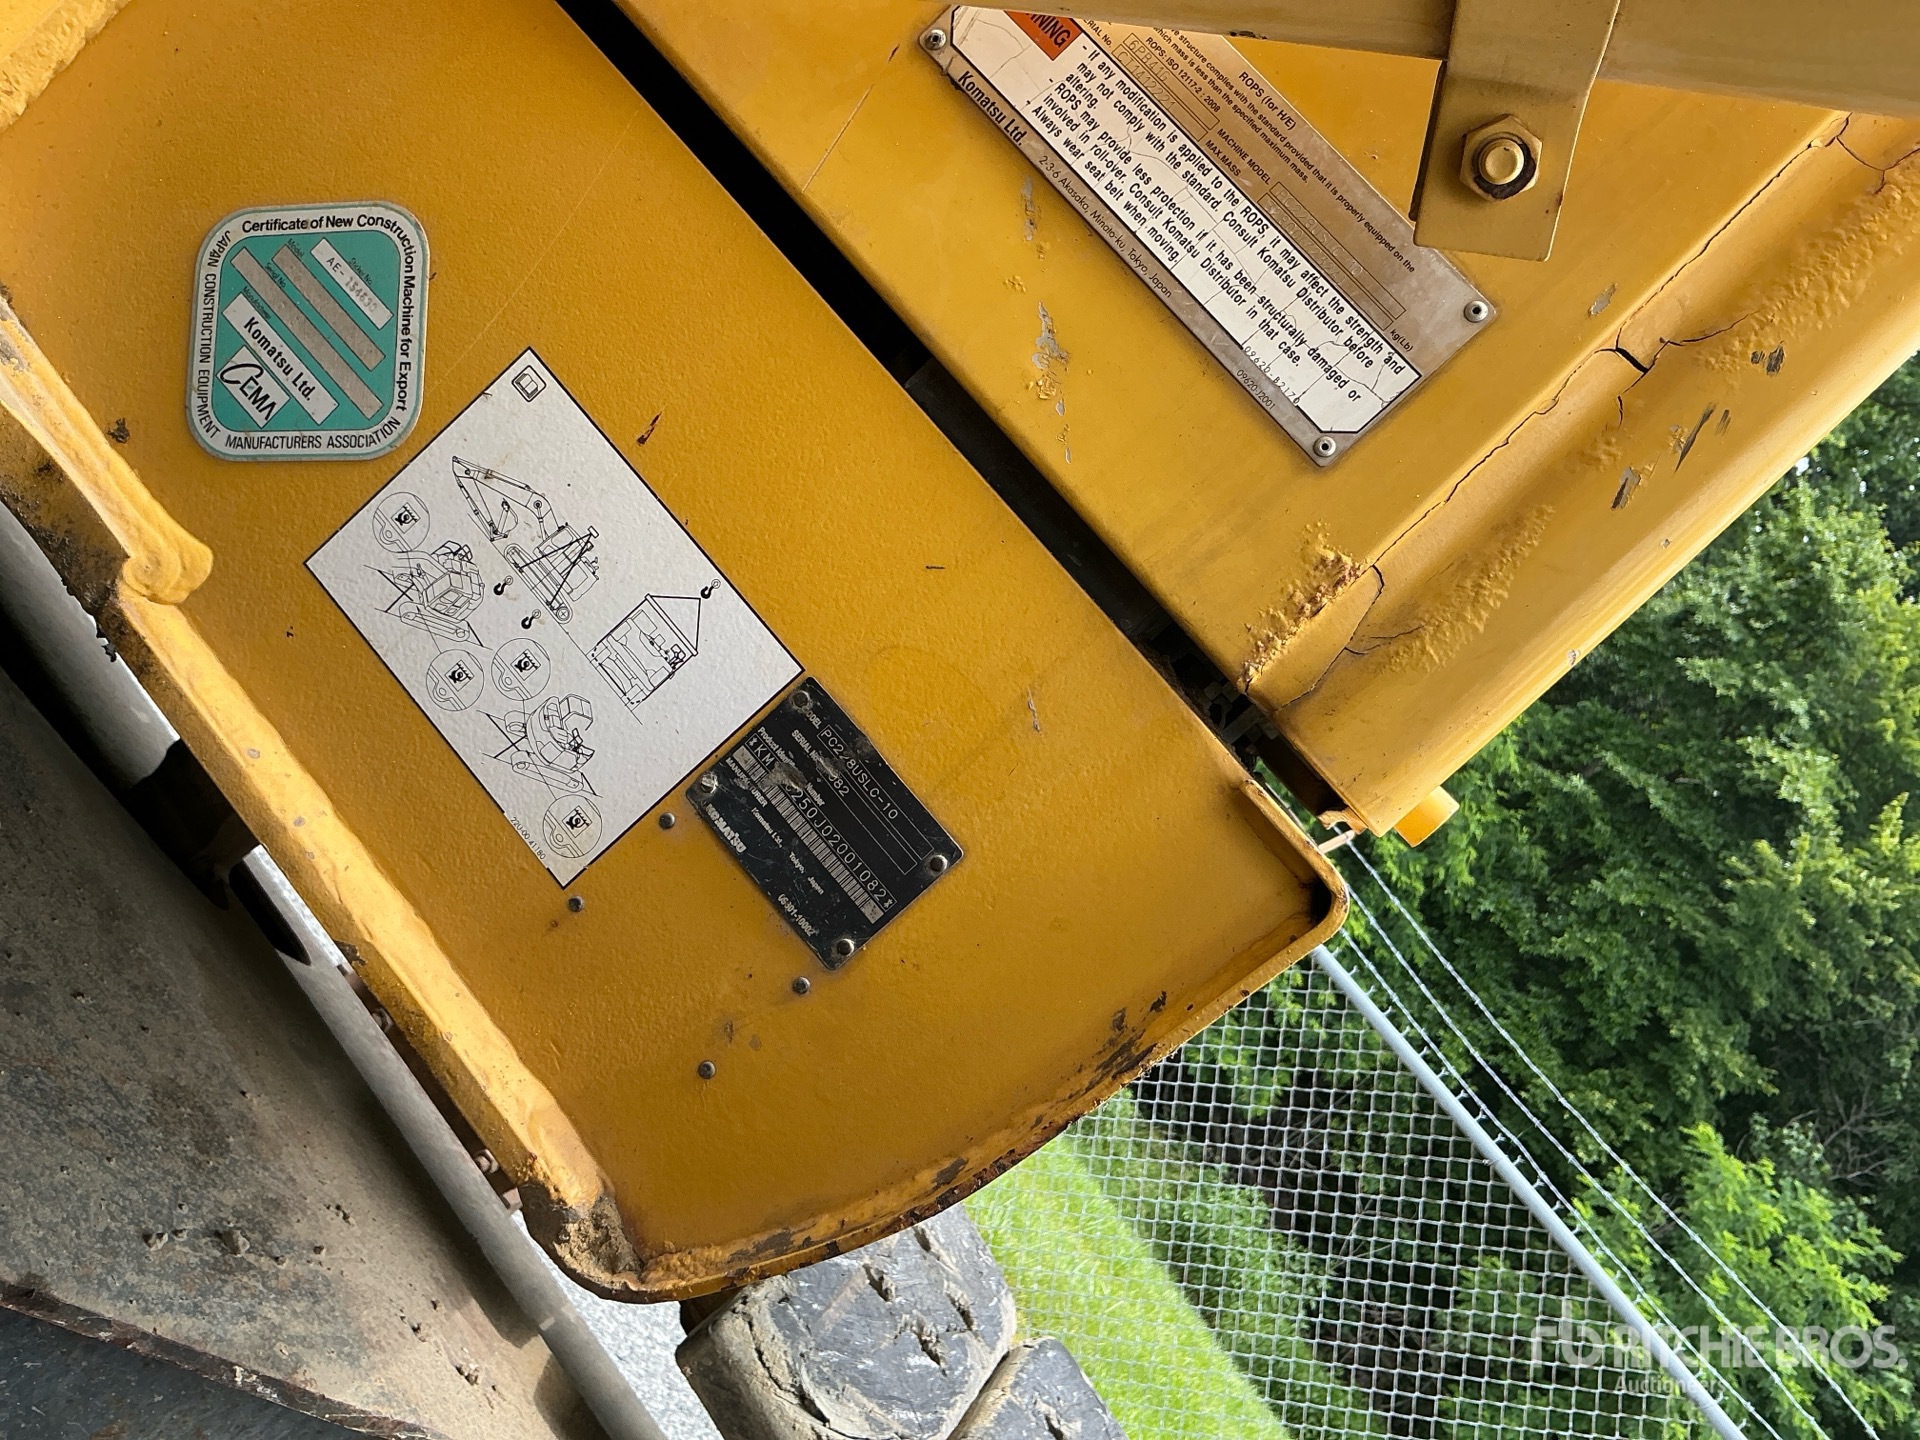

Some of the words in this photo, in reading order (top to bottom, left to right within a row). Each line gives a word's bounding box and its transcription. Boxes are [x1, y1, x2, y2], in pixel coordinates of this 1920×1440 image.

[1101, 34, 1114, 48] No.
[1062, 72, 1101, 111] altering.
[1145, 36, 1168, 59] ROPS:
[1164, 56, 1180, 71] ISO
[1176, 68, 1202, 94] 12117-2
[1203, 95, 1221, 113] 2008
[1170, 42, 1189, 61] mass
[1186, 58, 1196, 68] is
[1193, 64, 1209, 81] less
[1206, 77, 1223, 95] than
[1220, 92, 1234, 106] the
[1230, 102, 1262, 135] specified
[1259, 130, 1292, 164] maximum
[1237, 71, 1265, 98] ROPS
[1260, 94, 1279, 113] (for
[1275, 109, 1296, 131] H/E)
[956, 70, 1009, 124] Komatsu
[1002, 118, 1030, 147] Ltd.
[1177, 33, 1208, 64] structure
[1204, 60, 1235, 92] complies
[1232, 88, 1249, 105] with
[1246, 102, 1260, 116] the
[1256, 113, 1286, 143] standard
[1282, 139, 1314, 172] provided
[1311, 167, 1327, 183] that
[1324, 180, 1333, 189] it
[1329, 186, 1339, 196] is
[1335, 192, 1366, 224] properly
[1361, 219, 1395, 254] equipped
[1392, 250, 1404, 263] on
[1402, 259, 1416, 273] the
[1204, 139, 1241, 177] MAX.MASS
[1216, 127, 1249, 161] MACHINE
[1245, 158, 1273, 185] MODEL
[1029, 104, 1065, 140] Always
[1062, 137, 1085, 160] wear
[1083, 159, 1106, 182] seat
[1103, 179, 1125, 201] belt
[1121, 198, 1149, 227] when
[1143, 223, 1184, 265] moving.
[1087, 49, 1100, 62] If
[1094, 60, 1116, 82] any
[1114, 77, 1168, 132] modification
[1166, 129, 1180, 144] is
[1175, 141, 1213, 179] applied
[1210, 175, 1224, 190] to
[1222, 187, 1242, 207] the
[1237, 204, 1272, 239] ROPS,
[1268, 235, 1282, 248] it
[1276, 247, 1301, 272] may
[1299, 267, 1330, 298] affect
[1326, 295, 1347, 316] the
[1342, 313, 1385, 357] strength
[1382, 352, 1405, 376] and
[242, 218, 308, 233] Certificate
[310, 216, 324, 229] of
[325, 215, 353, 229] New
[356, 214, 416, 274] Construction
[1037, 154, 1062, 180] 2-3-6
[1056, 175, 1094, 213] Akasaka,
[1087, 208, 1130, 252] Minato-ku,
[1124, 247, 1153, 277] Tokyo,
[1146, 271, 1175, 299] Japan
[1042, 93, 1081, 132] involved
[1077, 129, 1092, 144] in
[1088, 142, 1131, 184] roll-over.
[1127, 181, 1165, 219] Consult
[1161, 216, 1203, 259] Komatsu
[1198, 256, 1249, 308] Distributor
[1245, 304, 1260, 320] in
[1257, 317, 1280, 341] that
[1276, 339, 1304, 367] case.
[1053, 82, 1082, 111] ROPS
[1077, 110, 1100, 133] may
[1096, 129, 1134, 167] provide
[1131, 162, 1154, 186] less
[1149, 183, 1198, 232] protection
[1195, 228, 1208, 241] if
[1214, 249, 1236, 271] has
[1233, 268, 1259, 295] been
[1253, 292, 1310, 349] structurally
[1303, 344, 1350, 391] damaged
[1346, 388, 1362, 403] or
[1074, 62, 1097, 85] may
[1095, 80, 1115, 100] not
[1110, 97, 1147, 134] comply
[1144, 129, 1167, 153] with
[1164, 150, 1184, 170] the
[1180, 167, 1224, 212] standard.
[1221, 209, 1259, 248] Consult
[1256, 246, 1298, 288] Komatsu
[1295, 286, 1346, 337] Distributor
[1342, 335, 1376, 369] before
[207, 230, 231, 267] JAPAN
[199, 273, 217, 363] CONSTRUCTION
[400, 275, 415, 336] Machine
[243, 317, 293, 376] Komatsu
[292, 372, 316, 401] Ltd.
[400, 338, 412, 358] for
[1388, 327, 1413, 353] kg(Lb)
[197, 369, 221, 439] EQUIPMENT
[396, 361, 411, 411] Export
[1234, 368, 1276, 410] 09620-J2001
[225, 435, 322, 450] MANUFACTURERS
[327, 416, 401, 449] ASSOCIATION
[790, 728, 813, 753] SERIAL
[803, 708, 823, 729] ODEL
[756, 726, 779, 750] Product
[803, 782, 827, 807] Number
[749, 806, 775, 834] Komatsu
[805, 874, 825, 895] Japan
